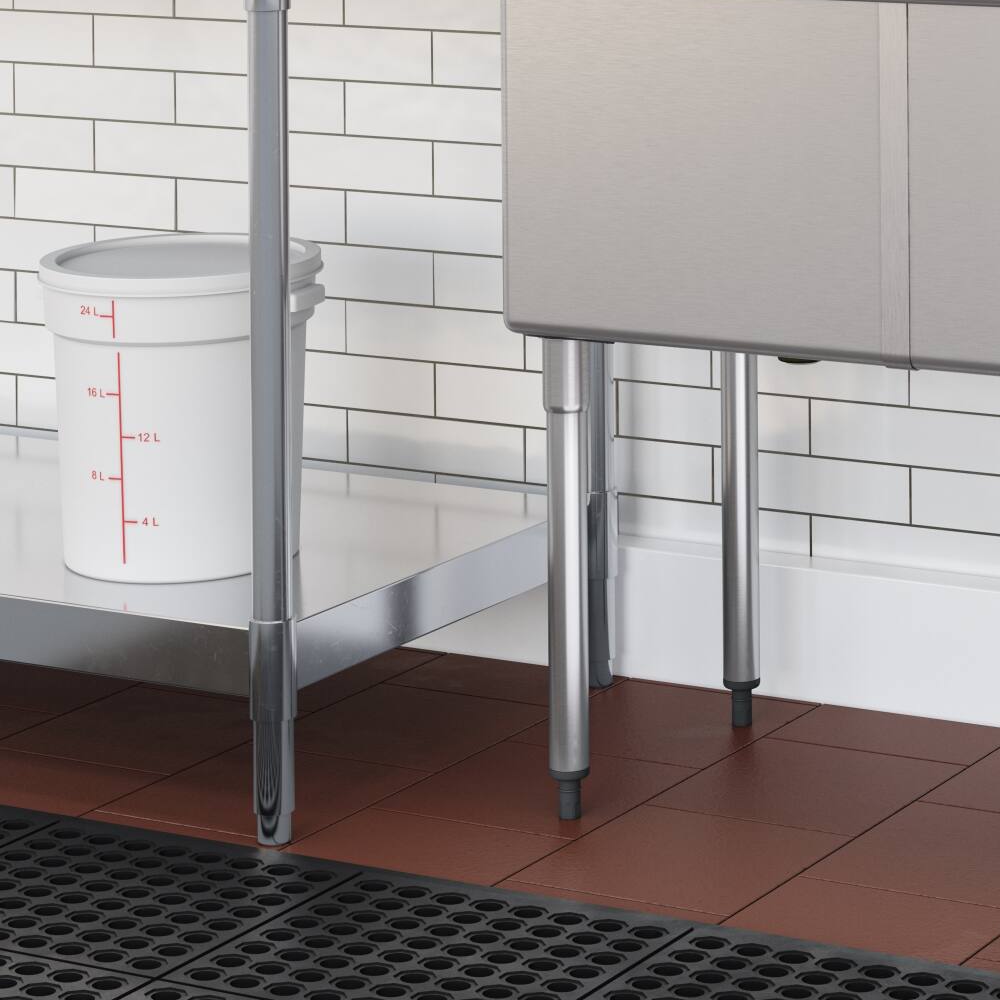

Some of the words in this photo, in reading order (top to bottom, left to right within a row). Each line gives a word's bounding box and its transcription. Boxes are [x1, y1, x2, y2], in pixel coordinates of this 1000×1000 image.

[80, 304, 91, 315] 24
[93, 306, 99, 317] L
[87, 387, 97, 397] 16
[100, 388, 105, 398] L
[138, 433, 150, 443] 12
[154, 433, 160, 443] L
[91, 470, 97, 480] 8
[99, 472, 104, 481] L
[142, 517, 148, 526] 4
[153, 517, 159, 527] L
